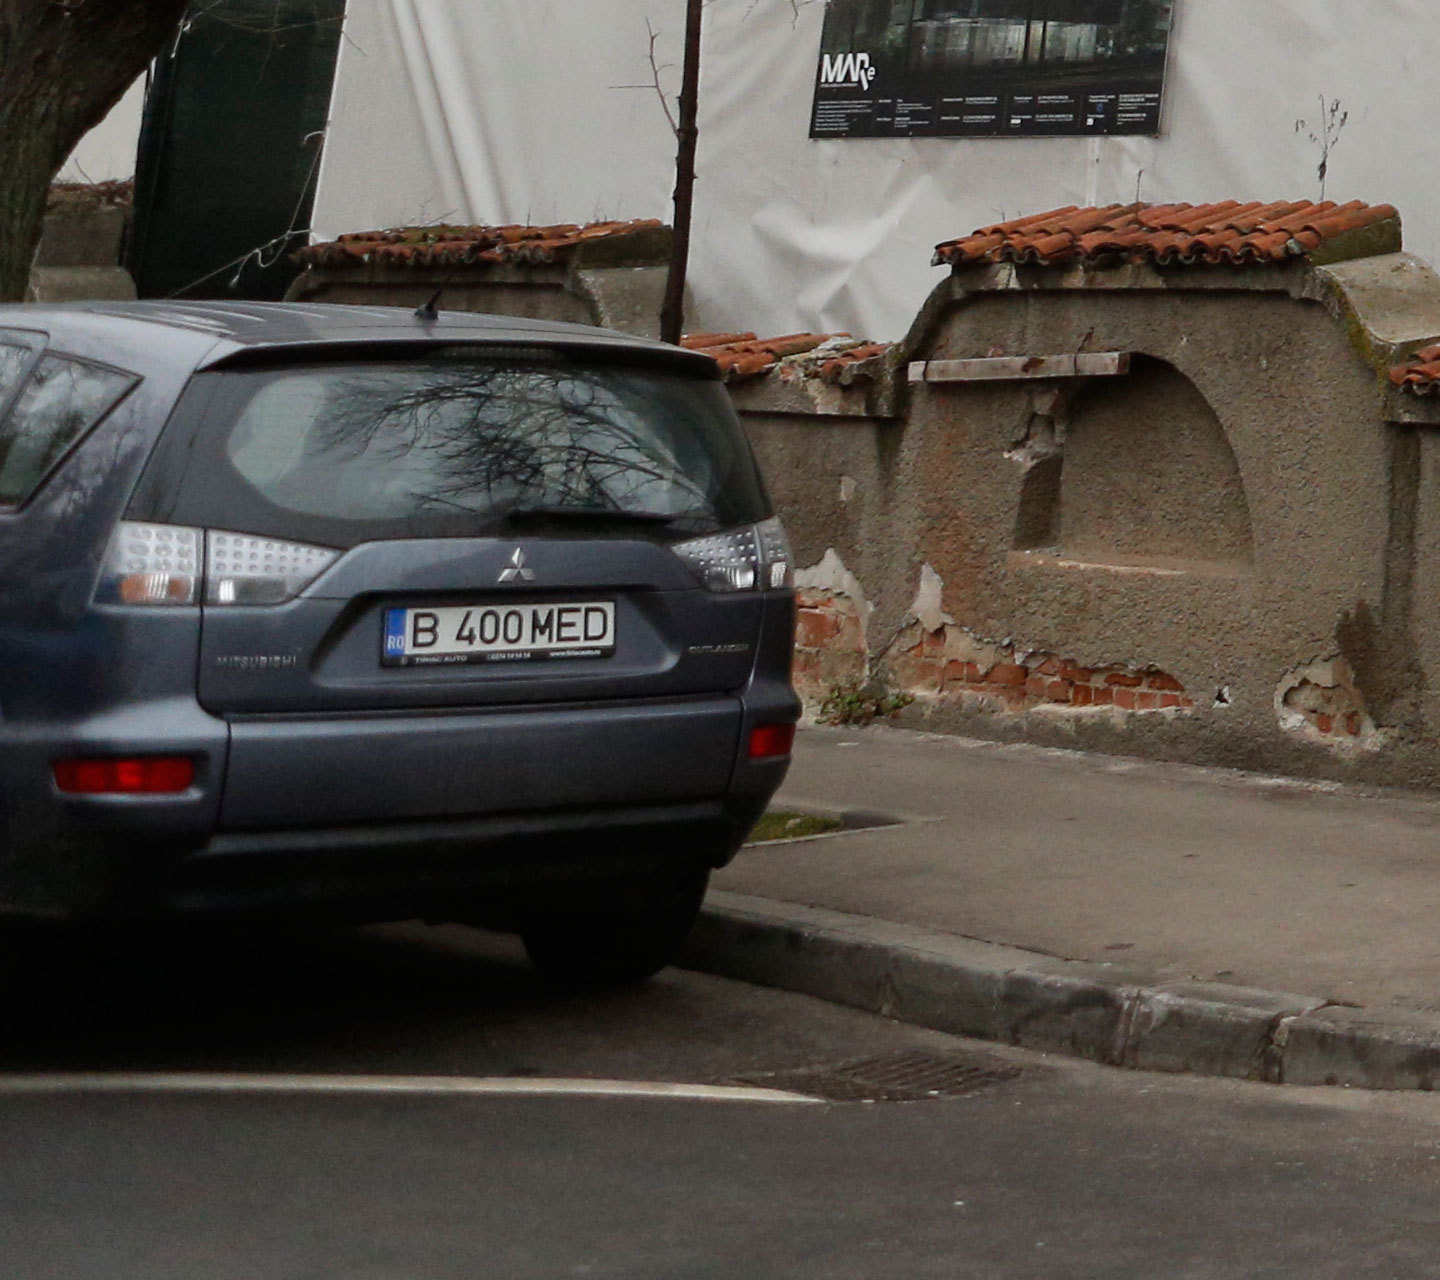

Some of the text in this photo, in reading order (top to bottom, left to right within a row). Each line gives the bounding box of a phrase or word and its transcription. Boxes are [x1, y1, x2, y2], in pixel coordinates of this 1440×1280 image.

[821, 52, 876, 91] MARe
[387, 606, 608, 650] RO B 400 MED
